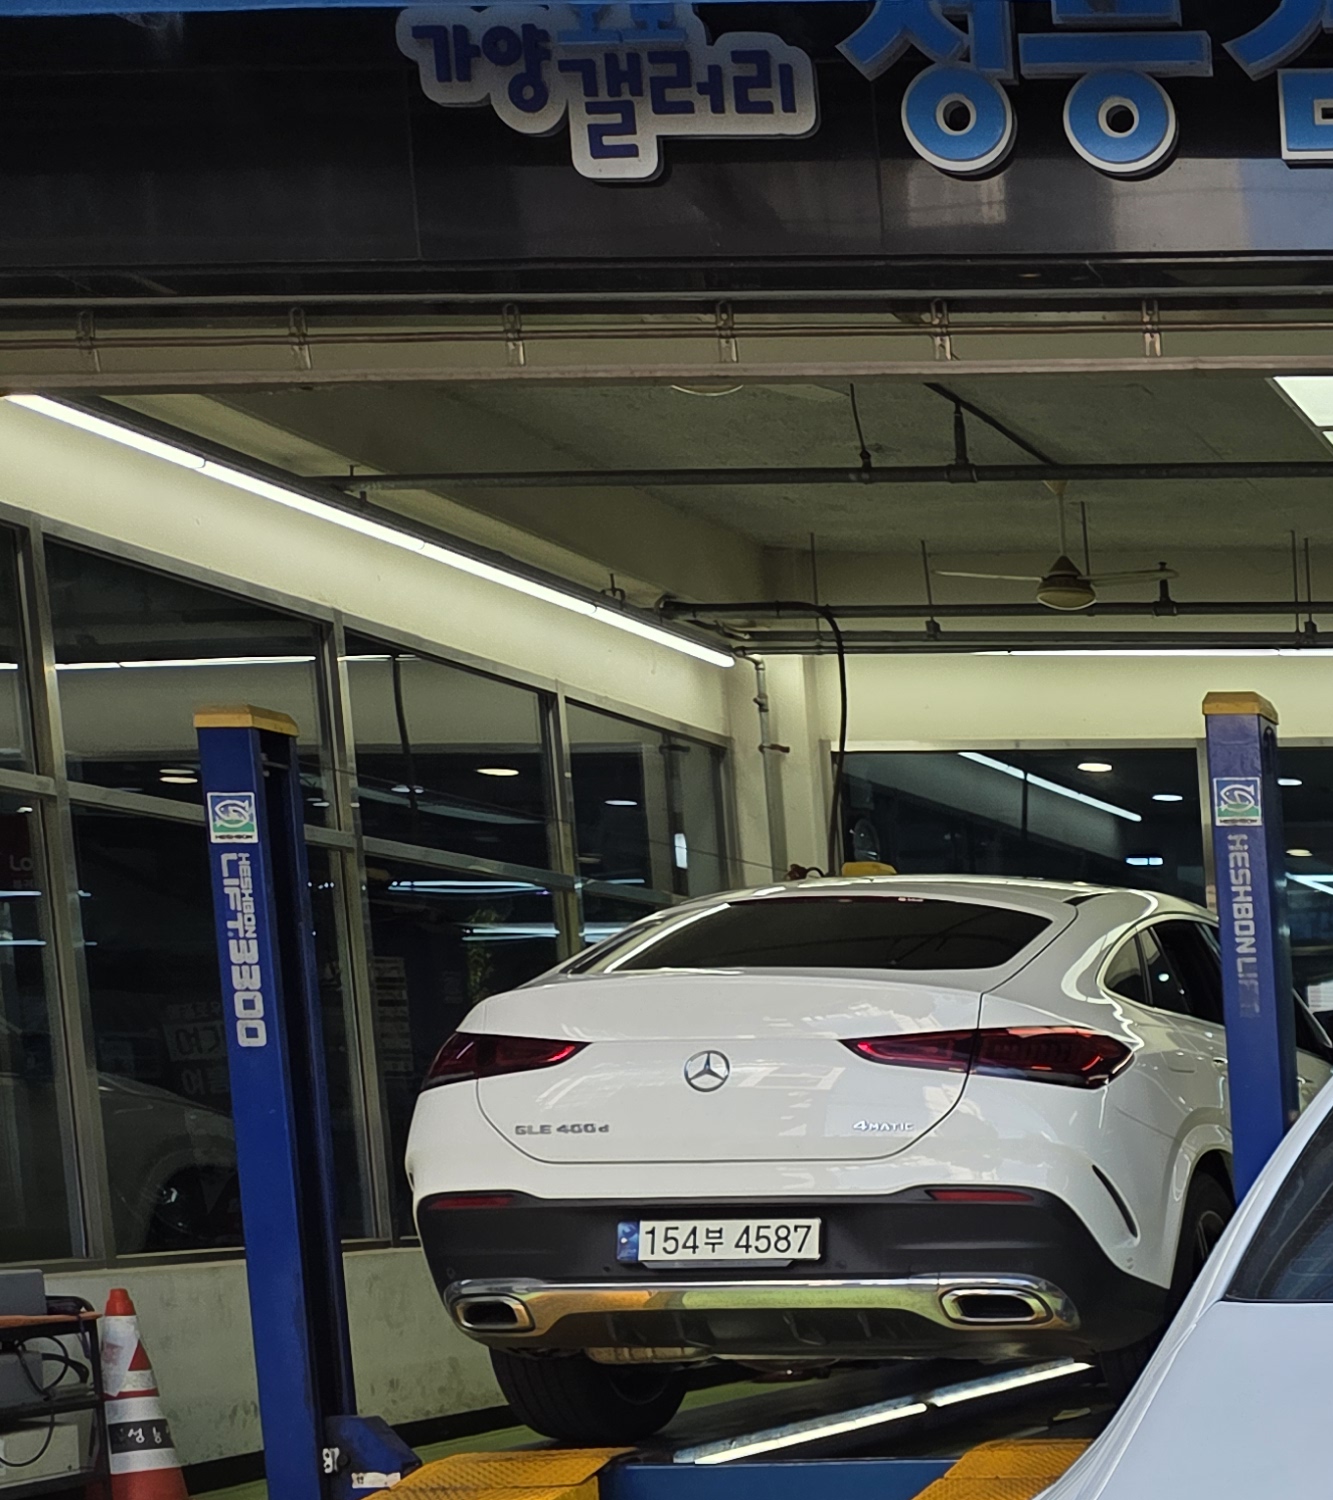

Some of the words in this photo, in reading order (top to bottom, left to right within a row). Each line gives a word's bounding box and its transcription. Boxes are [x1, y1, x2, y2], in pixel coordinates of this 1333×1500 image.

[557, 48, 798, 159] 갤러리
[237, 852, 257, 938] HESHBON
[1227, 833, 1257, 954] HESHBON
[515, 1124, 552, 1136] GLE
[852, 1119, 915, 1133] 4MATIC
[644, 1225, 725, 1255] 154부
[734, 1224, 812, 1254] 4587
